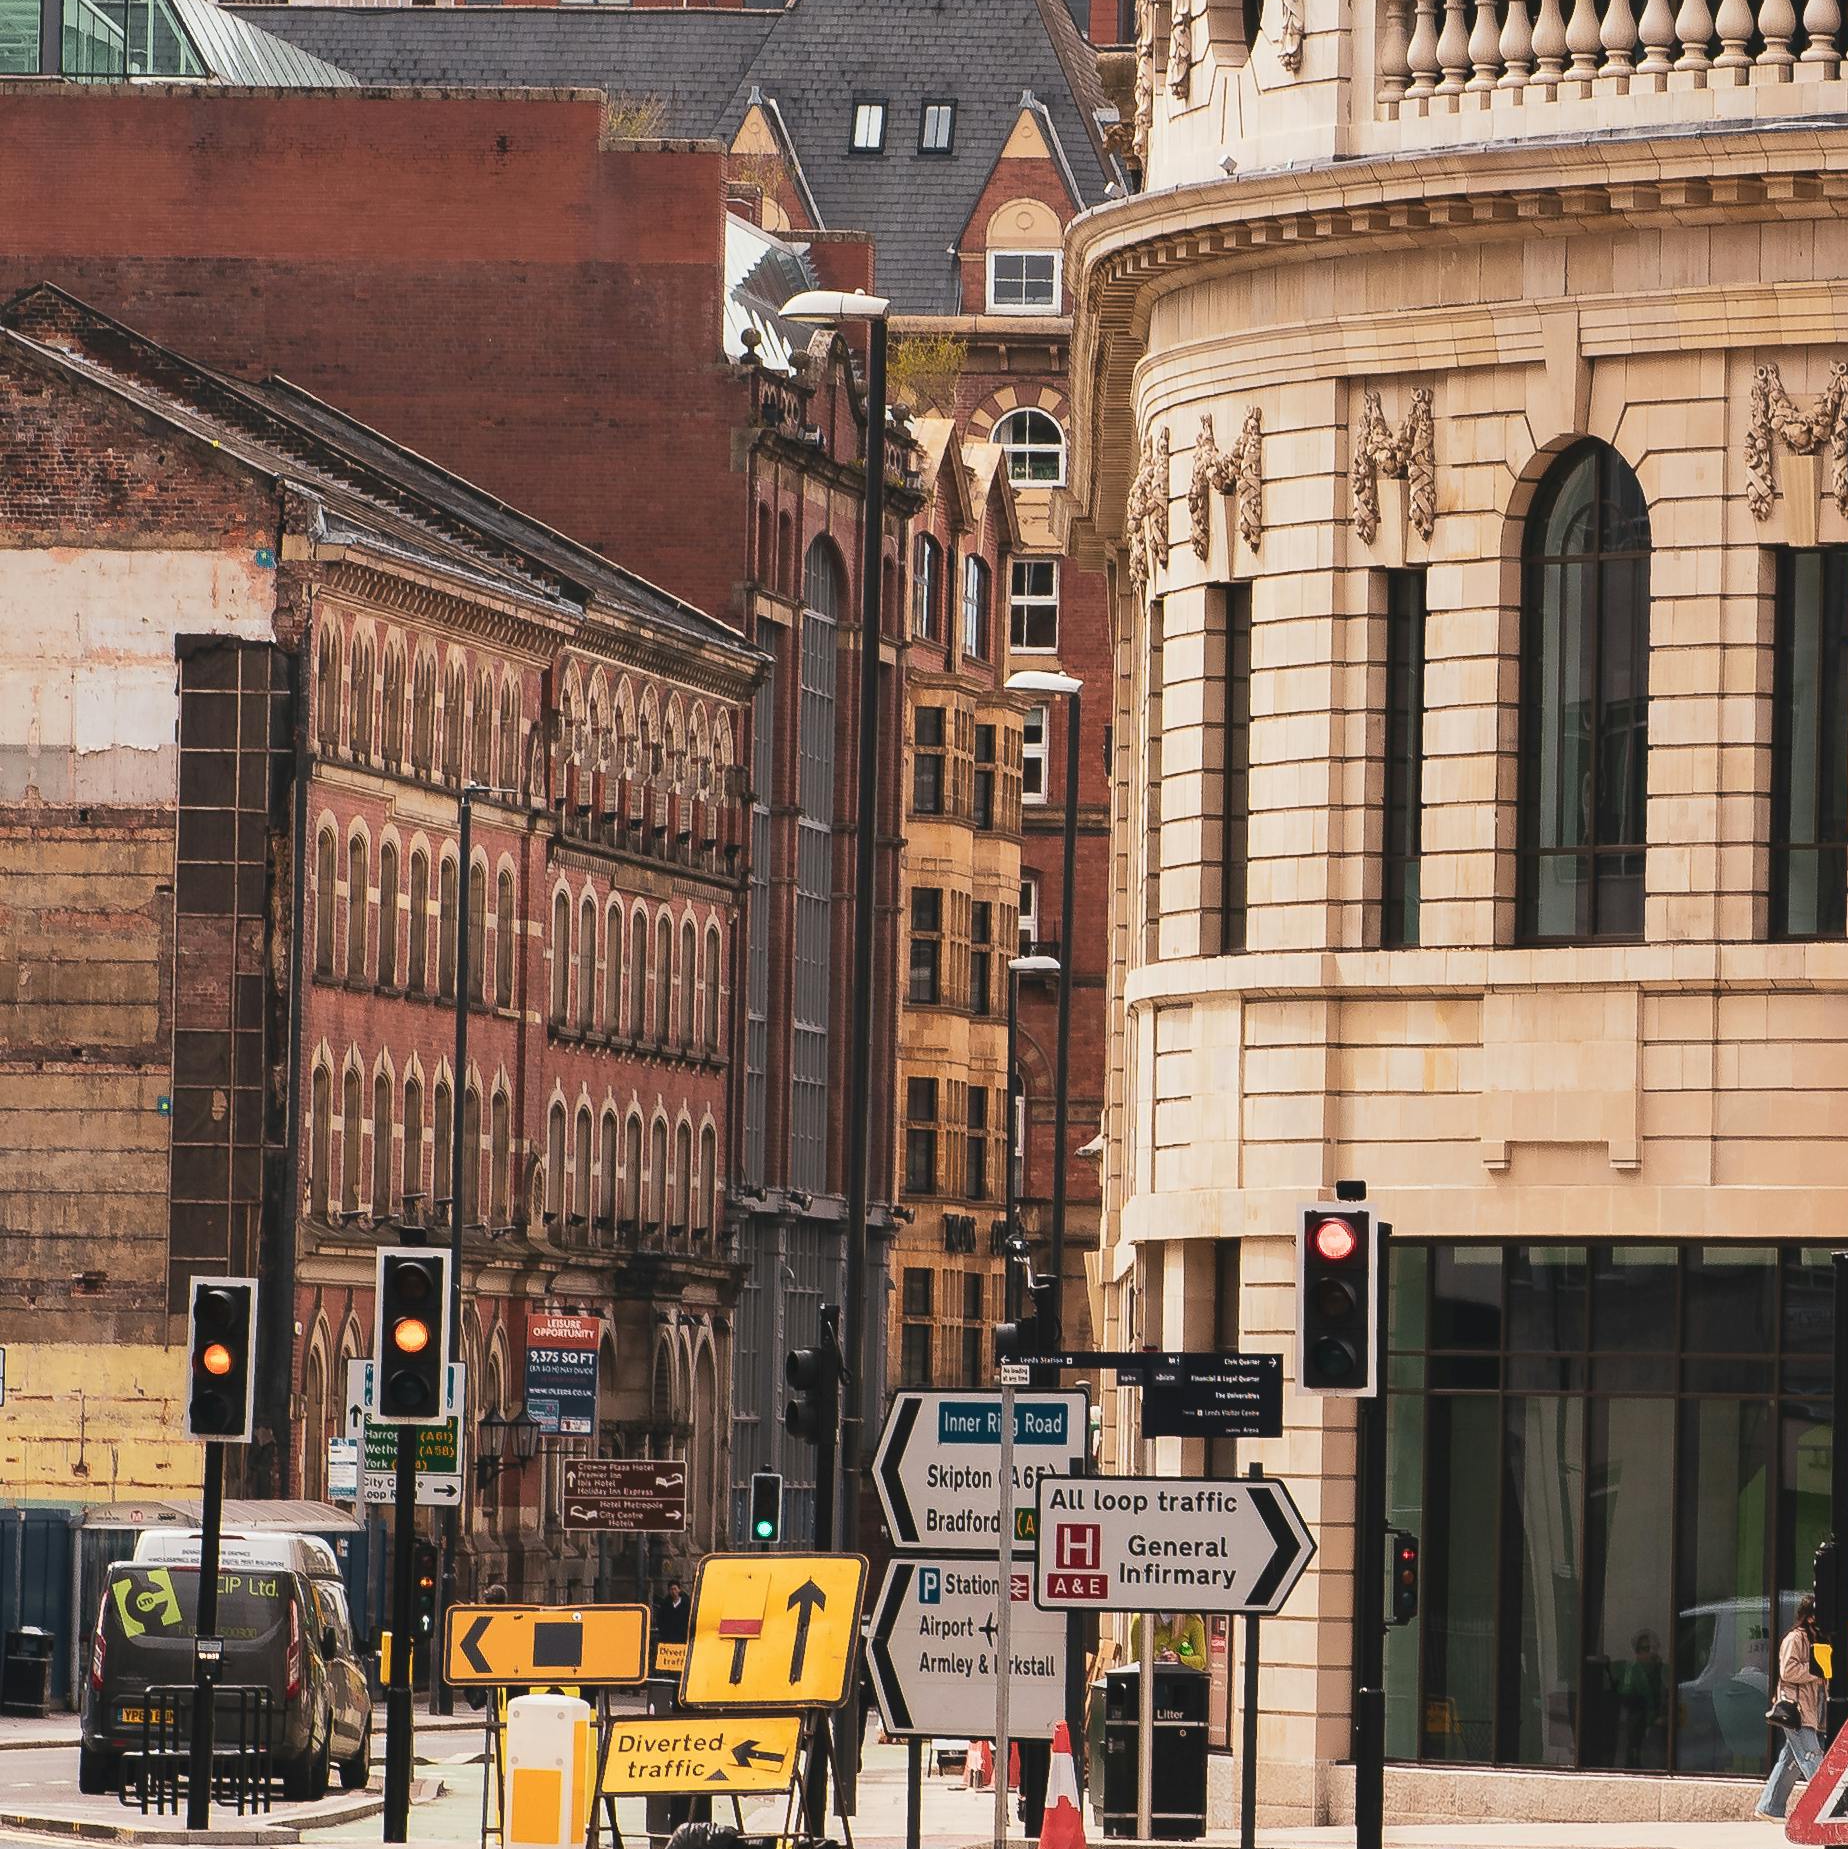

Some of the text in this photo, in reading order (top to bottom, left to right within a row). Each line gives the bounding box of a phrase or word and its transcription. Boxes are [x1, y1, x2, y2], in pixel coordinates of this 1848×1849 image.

[533, 1328, 594, 1339] OPPORTUNITY
[547, 1319, 582, 1329] LEISURE
[530, 1351, 594, 1365] 9,375 SQ FT
[944, 1412, 1062, 1437] Inner Rig Road
[365, 1459, 388, 1468] York
[632, 1463, 655, 1471] Hotel
[927, 1463, 992, 1492] Skipton
[1050, 1488, 1238, 1515] All loop traffic
[599, 1512, 643, 1520] City Centre
[609, 1520, 634, 1528] Hotels
[926, 1508, 1000, 1533] Bradford
[1128, 1534, 1228, 1558] General
[945, 1573, 999, 1595] Station
[1054, 1577, 1100, 1595] A & E
[1119, 1563, 1237, 1590] Infirmary
[249, 1577, 279, 1597] Ltd.
[919, 1615, 975, 1640] Airport
[660, 1647, 687, 1657] Diver
[919, 1652, 1056, 1677] Armley & rkstall
[1157, 1709, 1184, 1720] Litter
[618, 1733, 724, 1753] Diverted
[628, 1760, 705, 1779] traffic
